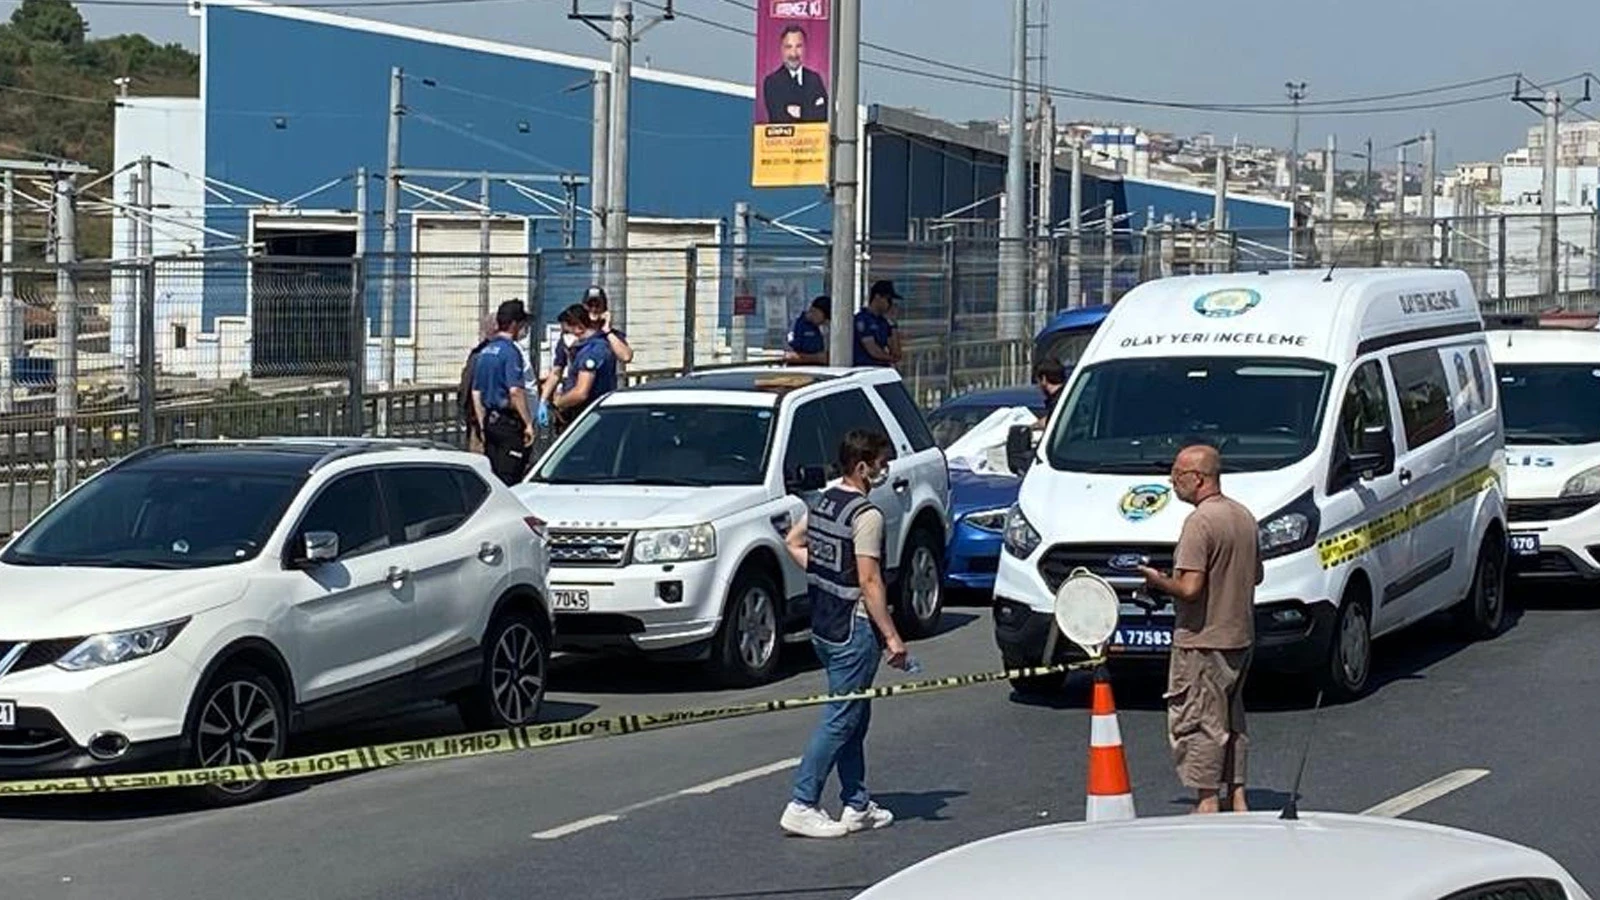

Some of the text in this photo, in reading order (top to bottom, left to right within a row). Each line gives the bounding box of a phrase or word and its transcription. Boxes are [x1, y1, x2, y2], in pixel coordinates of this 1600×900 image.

[1120, 334, 1164, 348] OLAY
[555, 592, 587, 607] 7045
[1114, 630, 1172, 645] A 77583
